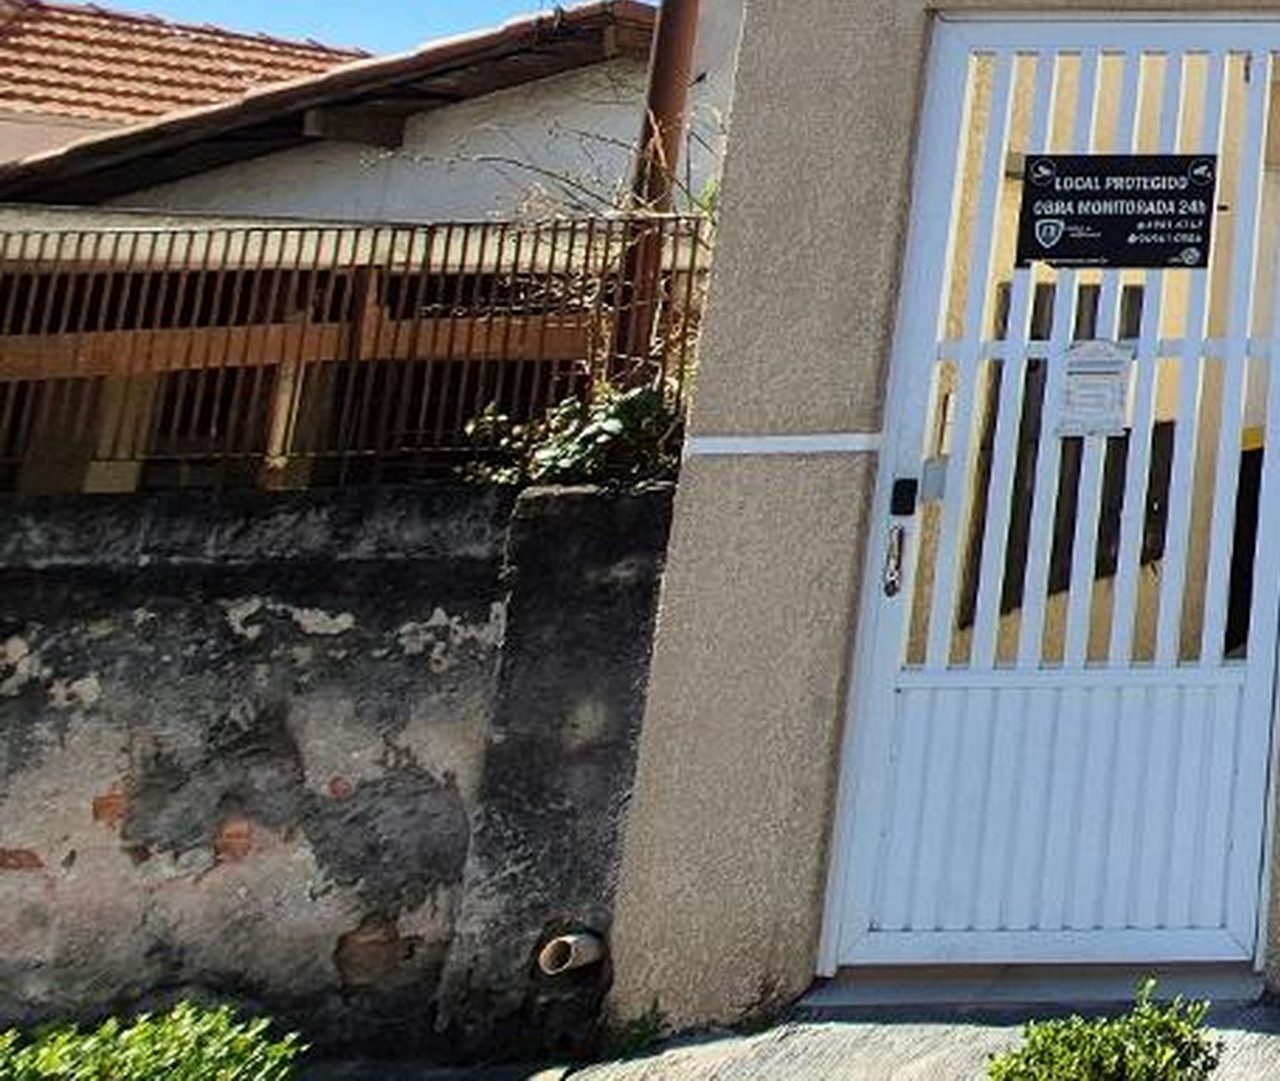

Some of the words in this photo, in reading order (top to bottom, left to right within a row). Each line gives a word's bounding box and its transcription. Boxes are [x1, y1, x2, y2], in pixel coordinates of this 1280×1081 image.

[1054, 176, 1100, 191] LOCAL
[1105, 176, 1188, 191] PROTEGIDO
[1033, 200, 1074, 215] OBRA
[1077, 200, 1175, 215] MONITORADA
